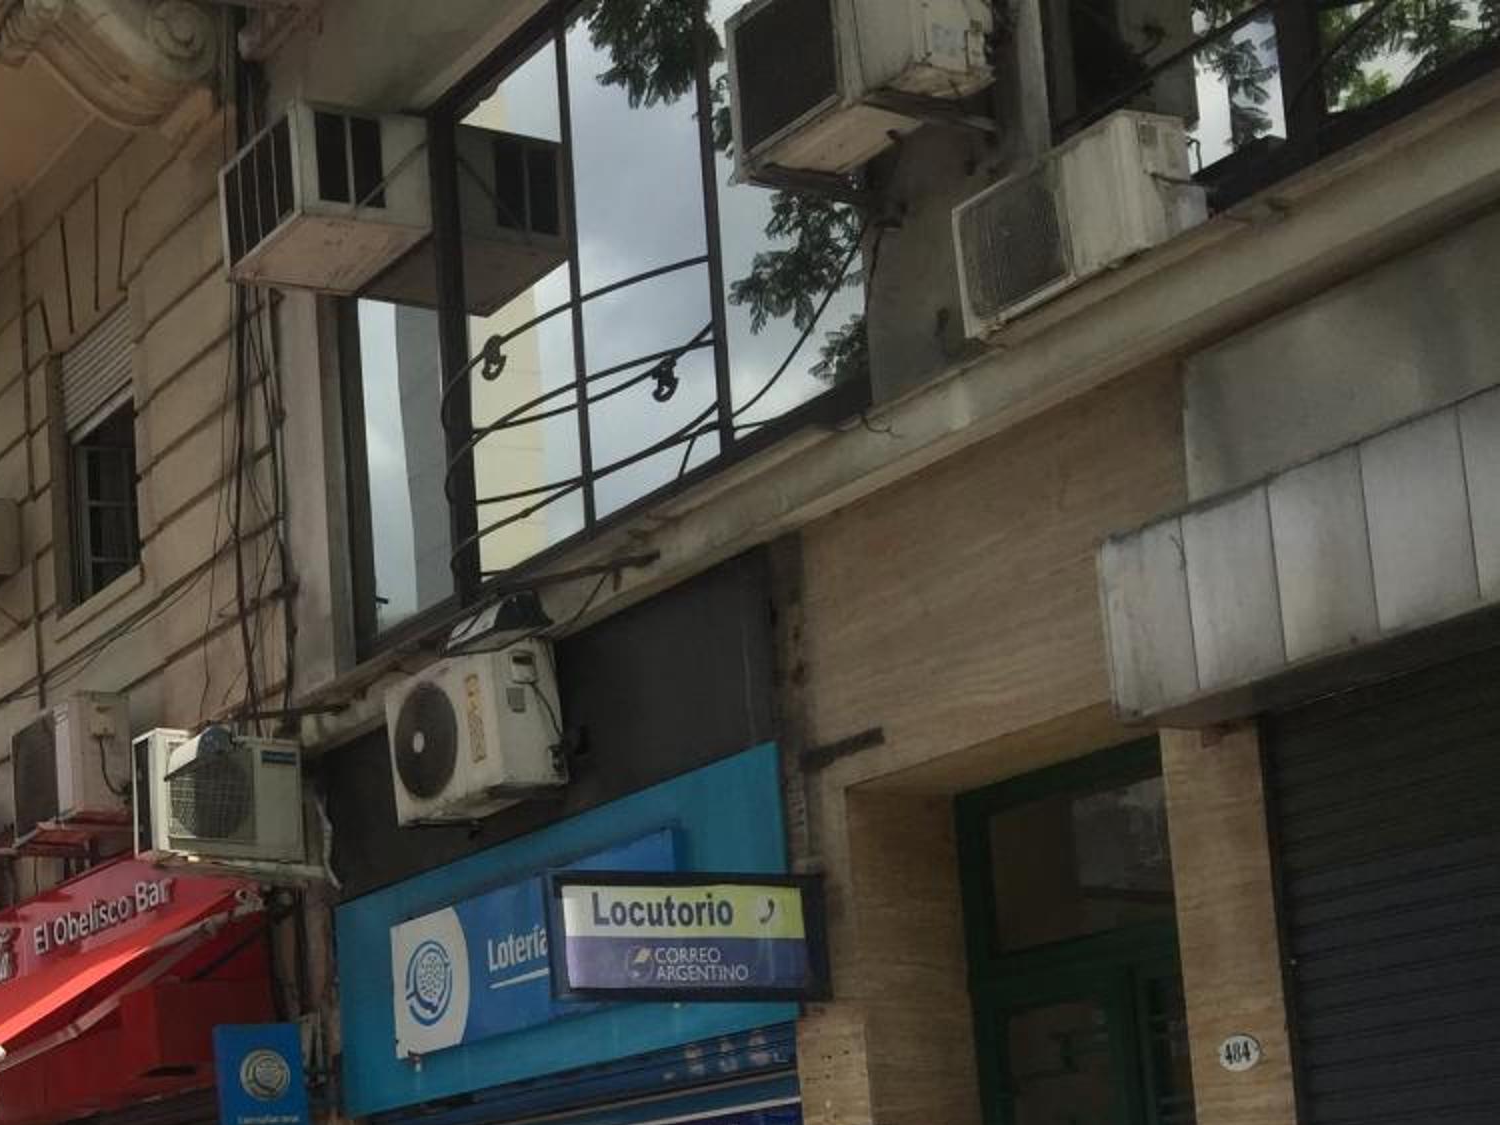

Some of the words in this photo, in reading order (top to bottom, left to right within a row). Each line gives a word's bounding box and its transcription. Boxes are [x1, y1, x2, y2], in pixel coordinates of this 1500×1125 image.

[34, 925, 49, 955] El
[53, 895, 129, 946] Obelisco
[134, 878, 173, 912] Bar
[592, 892, 734, 927] Locutorio
[654, 947, 721, 964] CORREO
[656, 964, 749, 982] ARGENTINO
